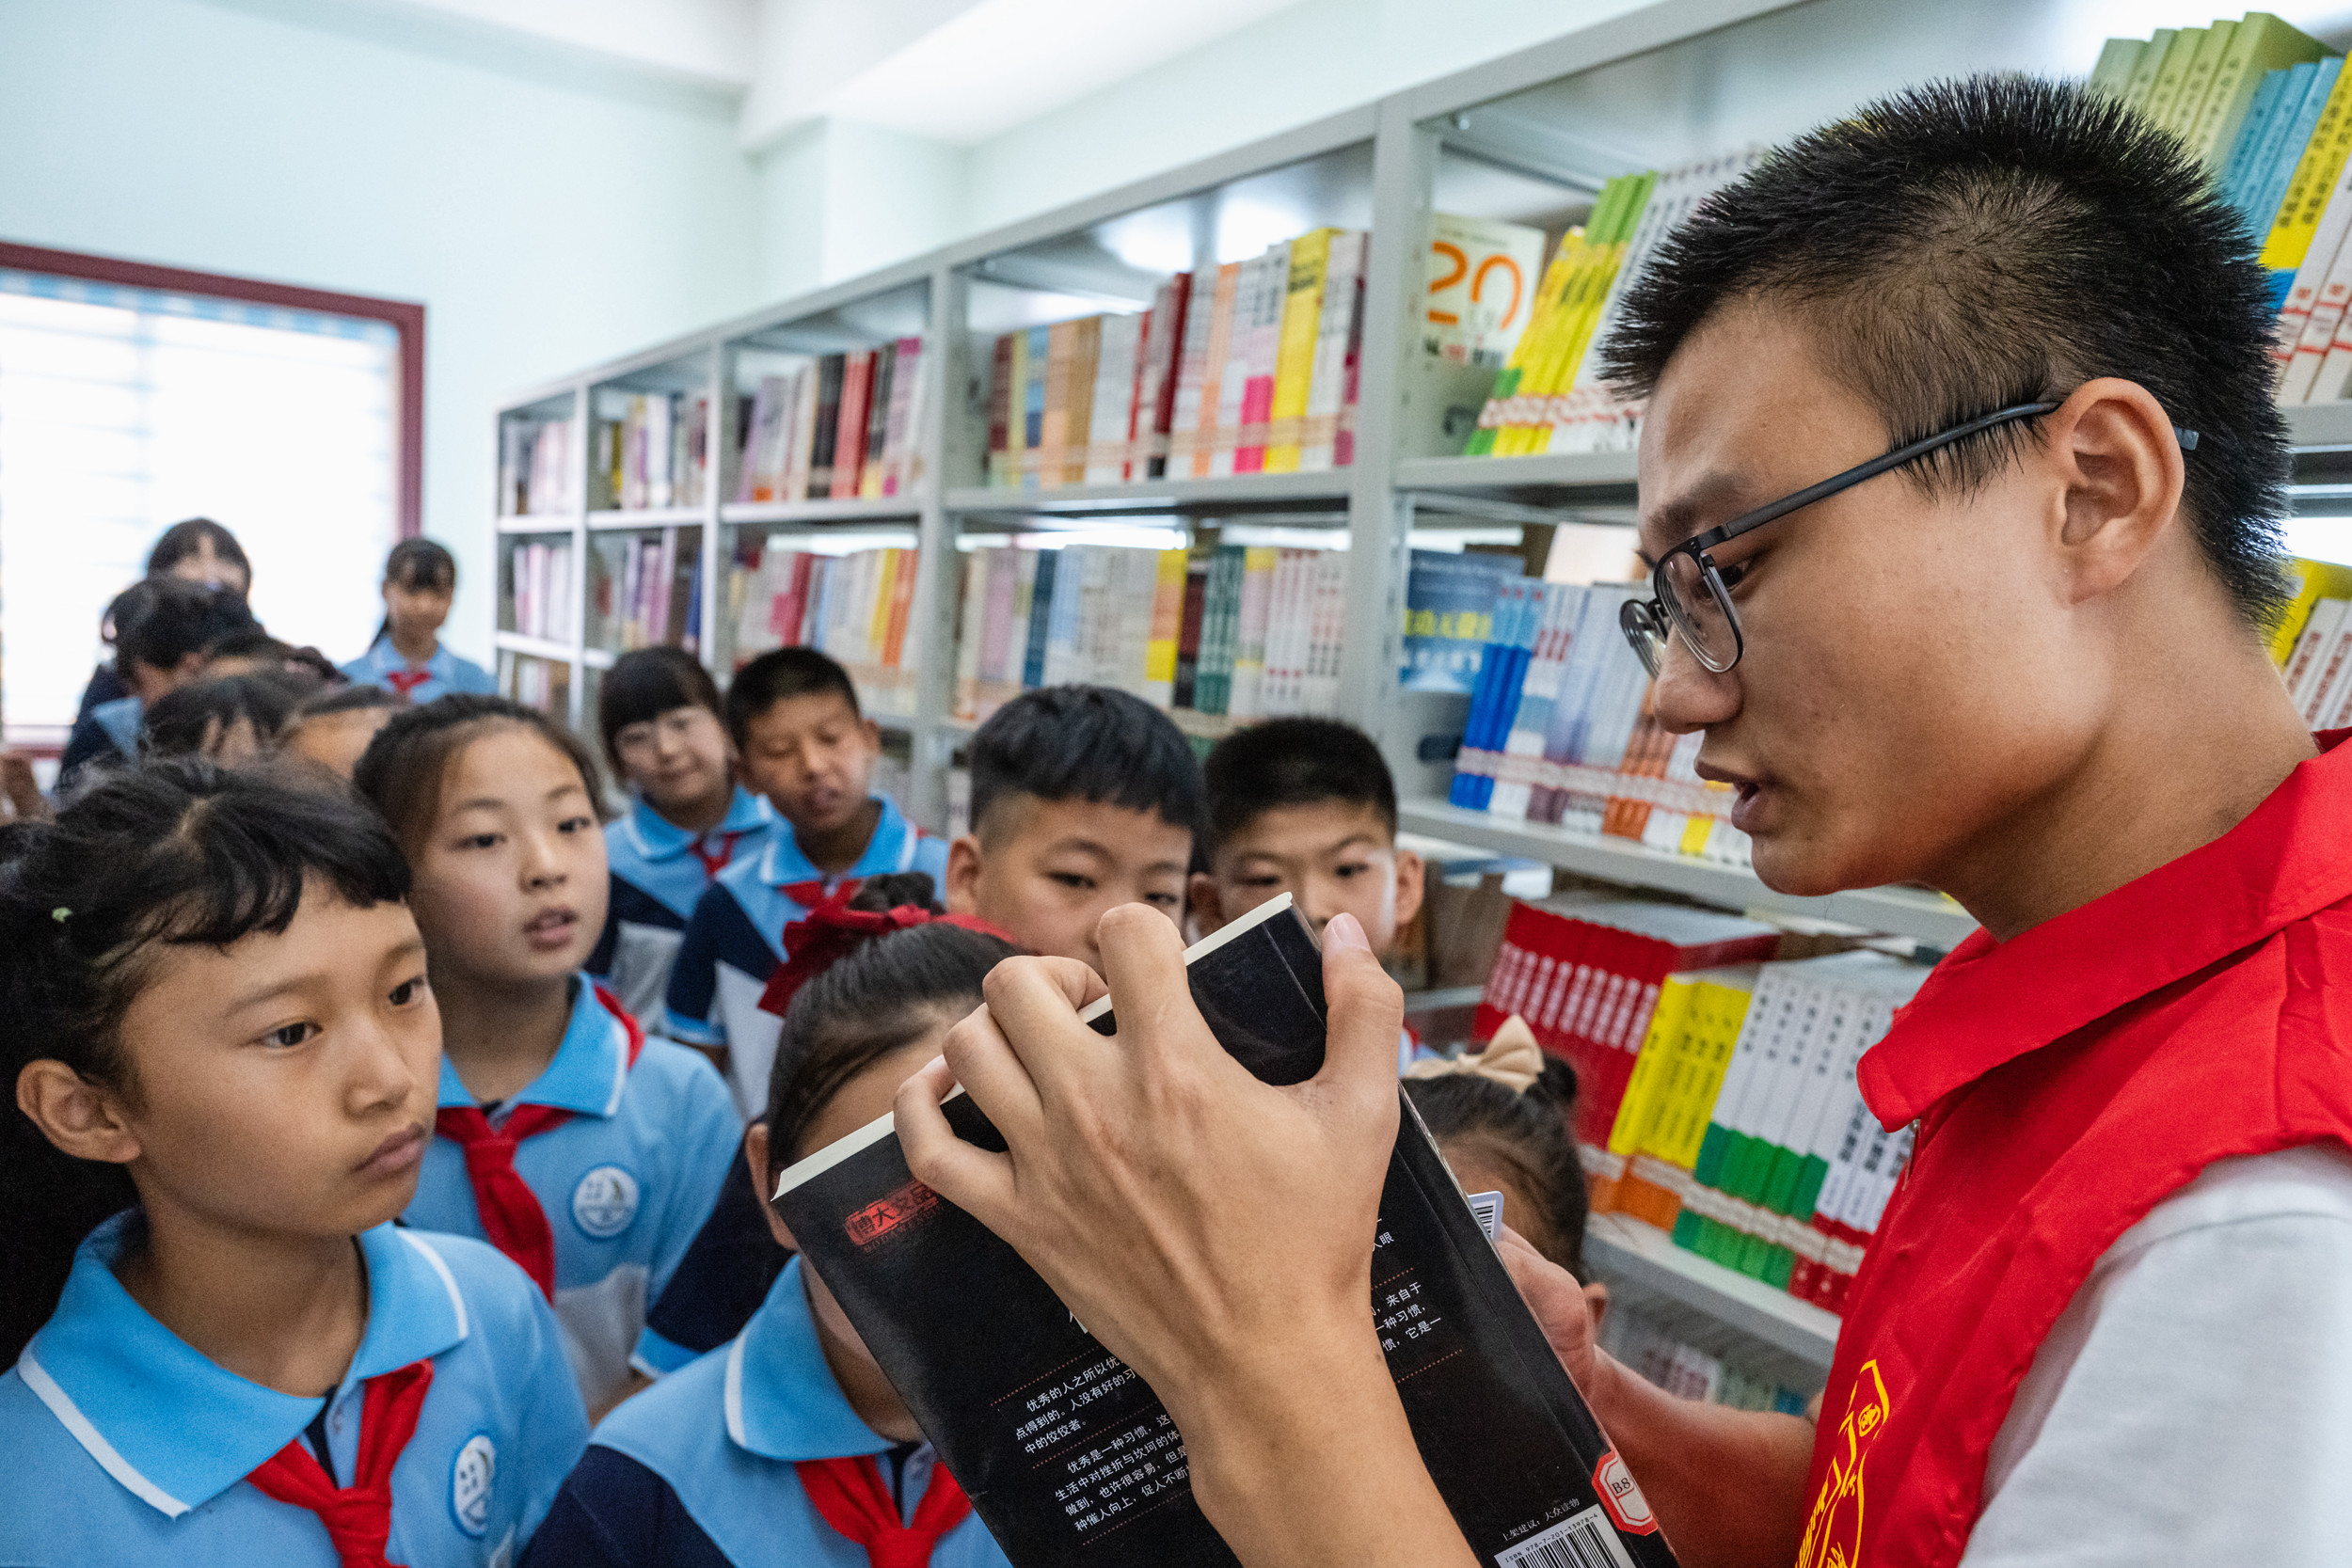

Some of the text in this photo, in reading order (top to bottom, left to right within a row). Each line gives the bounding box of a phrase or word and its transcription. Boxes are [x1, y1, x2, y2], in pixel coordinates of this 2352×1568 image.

[1026, 1356, 1123, 1412] 优秀的人之所以优
[1025, 1418, 1087, 1454] 中的佼佼者。
[1055, 1430, 1180, 1501] 生活中对挫折与坎坷的体
[1612, 1477, 1630, 1495] B8
[1074, 1465, 1189, 1532] 种催人向上，促人不断
[1504, 1513, 1598, 1563] ISBN 978-7-201-13978-4
